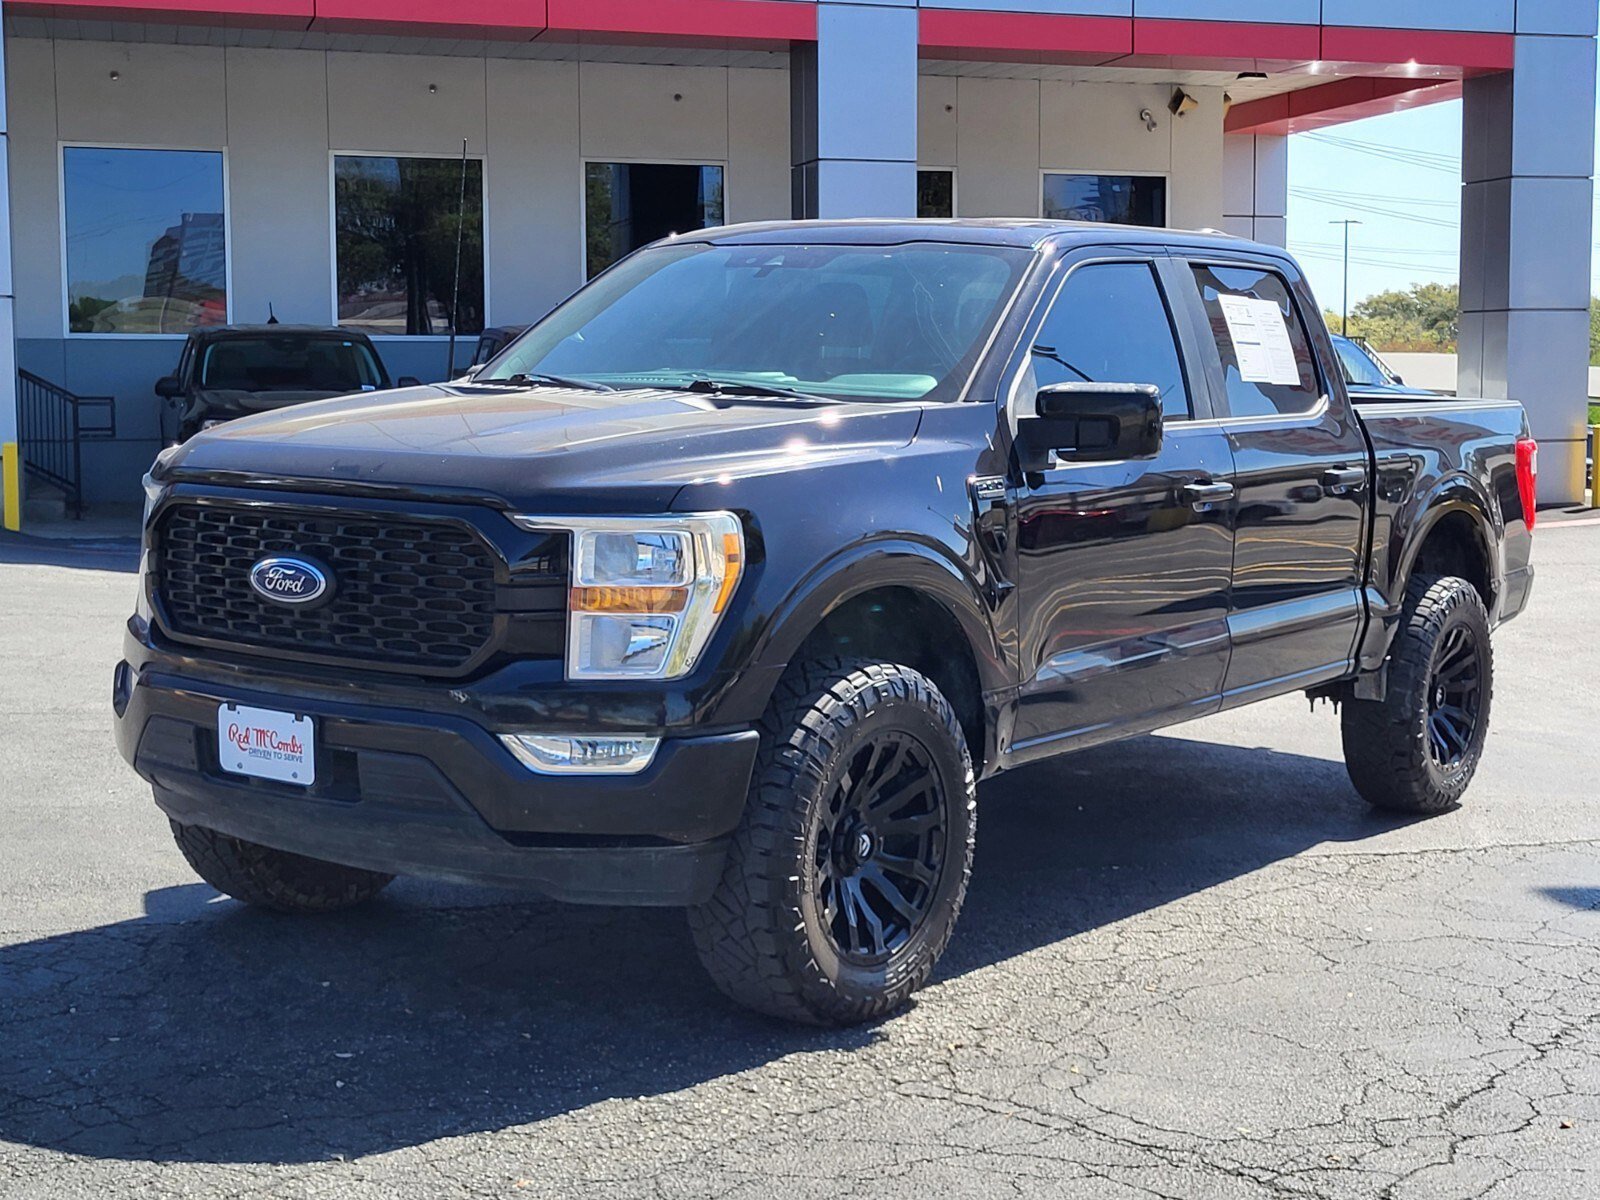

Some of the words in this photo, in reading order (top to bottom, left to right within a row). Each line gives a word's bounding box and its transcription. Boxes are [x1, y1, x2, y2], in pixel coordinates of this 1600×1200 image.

[265, 566, 305, 593] Ford
[228, 723, 250, 752] Red
[252, 727, 303, 755] McCombs
[248, 747, 272, 758] DRIVEN
[273, 751, 282, 759] TO
[284, 753, 303, 763] SERVE
